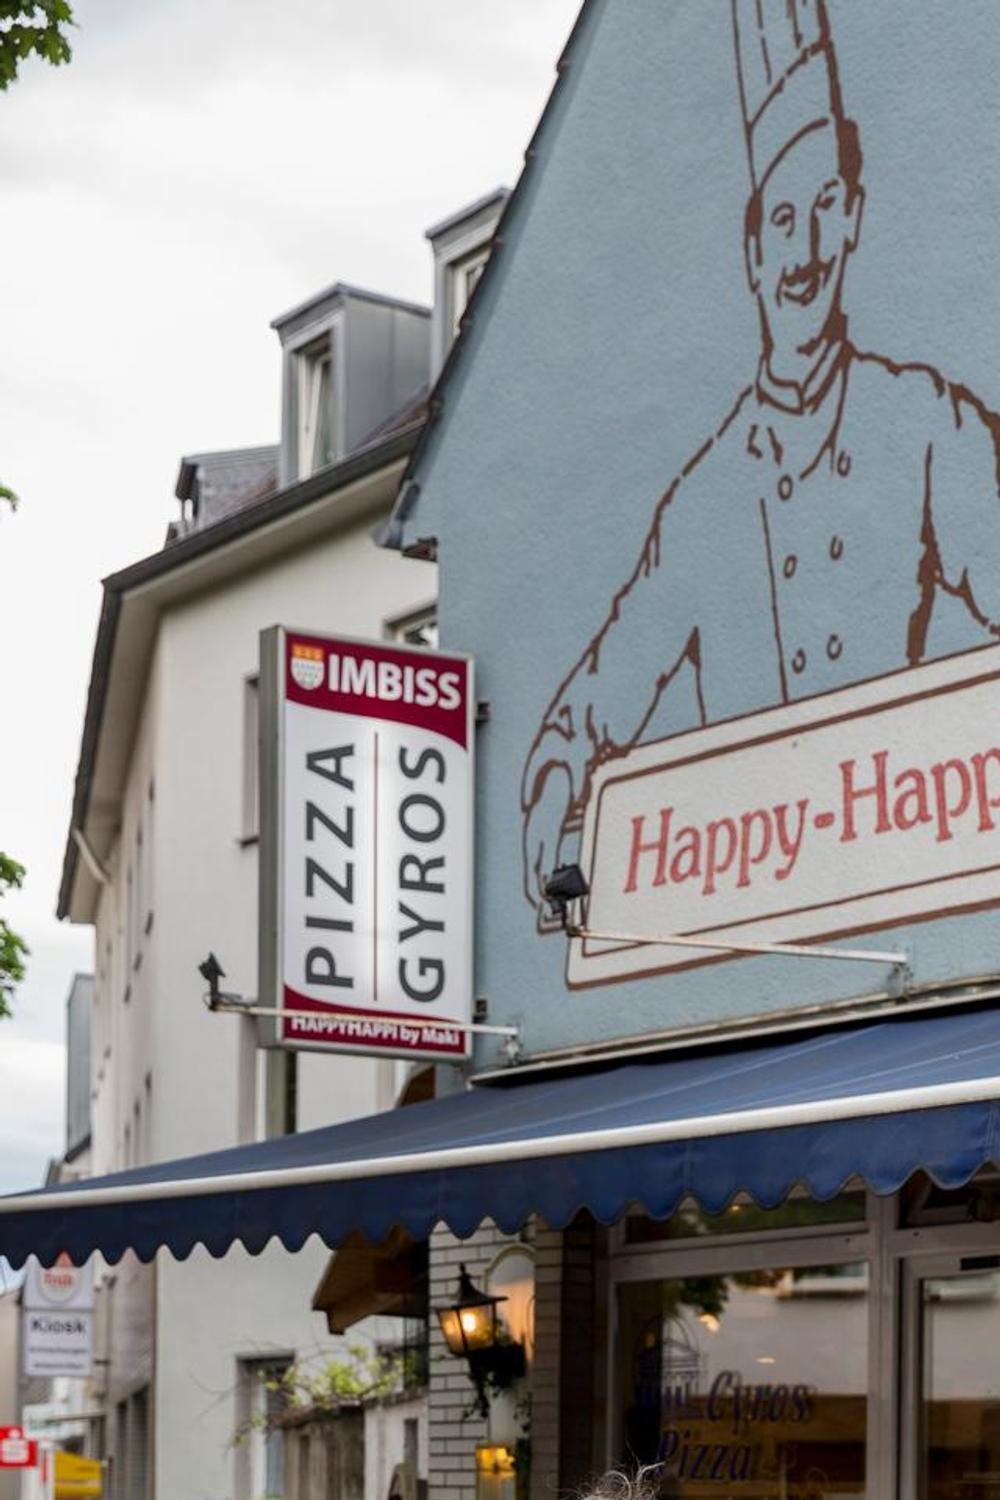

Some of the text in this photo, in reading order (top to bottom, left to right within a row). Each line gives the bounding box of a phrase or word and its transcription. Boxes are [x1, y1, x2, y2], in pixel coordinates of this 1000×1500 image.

[328, 653, 461, 711] IMBISS
[305, 743, 354, 989] PIZZA
[398, 745, 446, 1003] GYROS
[31, 1317, 86, 1335] Kiosk
[707, 1369, 810, 1435] Gyros
[655, 1427, 753, 1482] Pizza
